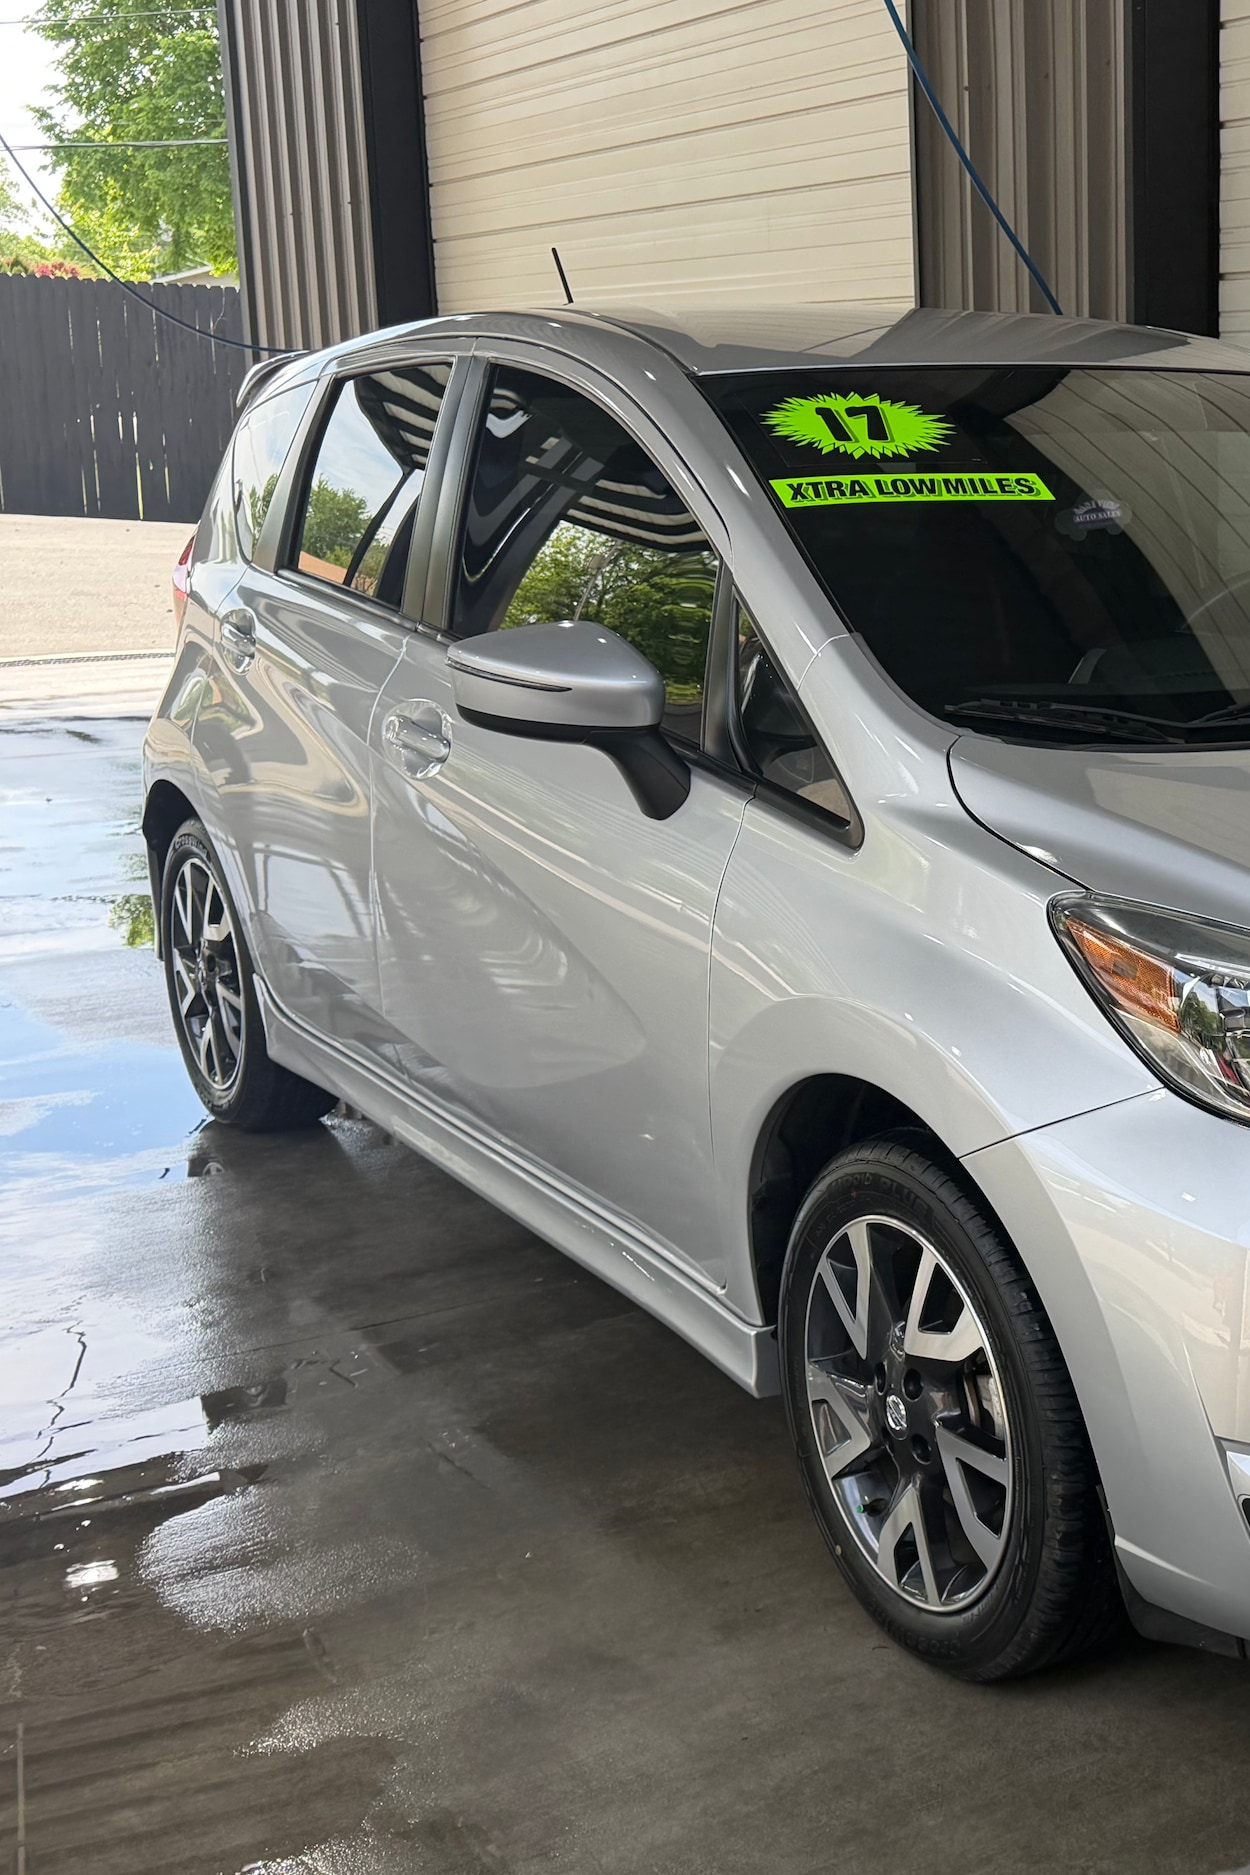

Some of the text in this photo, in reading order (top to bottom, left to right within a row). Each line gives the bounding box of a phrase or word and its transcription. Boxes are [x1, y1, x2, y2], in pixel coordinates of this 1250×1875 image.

[815, 405, 893, 442] 17
[787, 477, 1039, 502] XTRA LOW MILES
